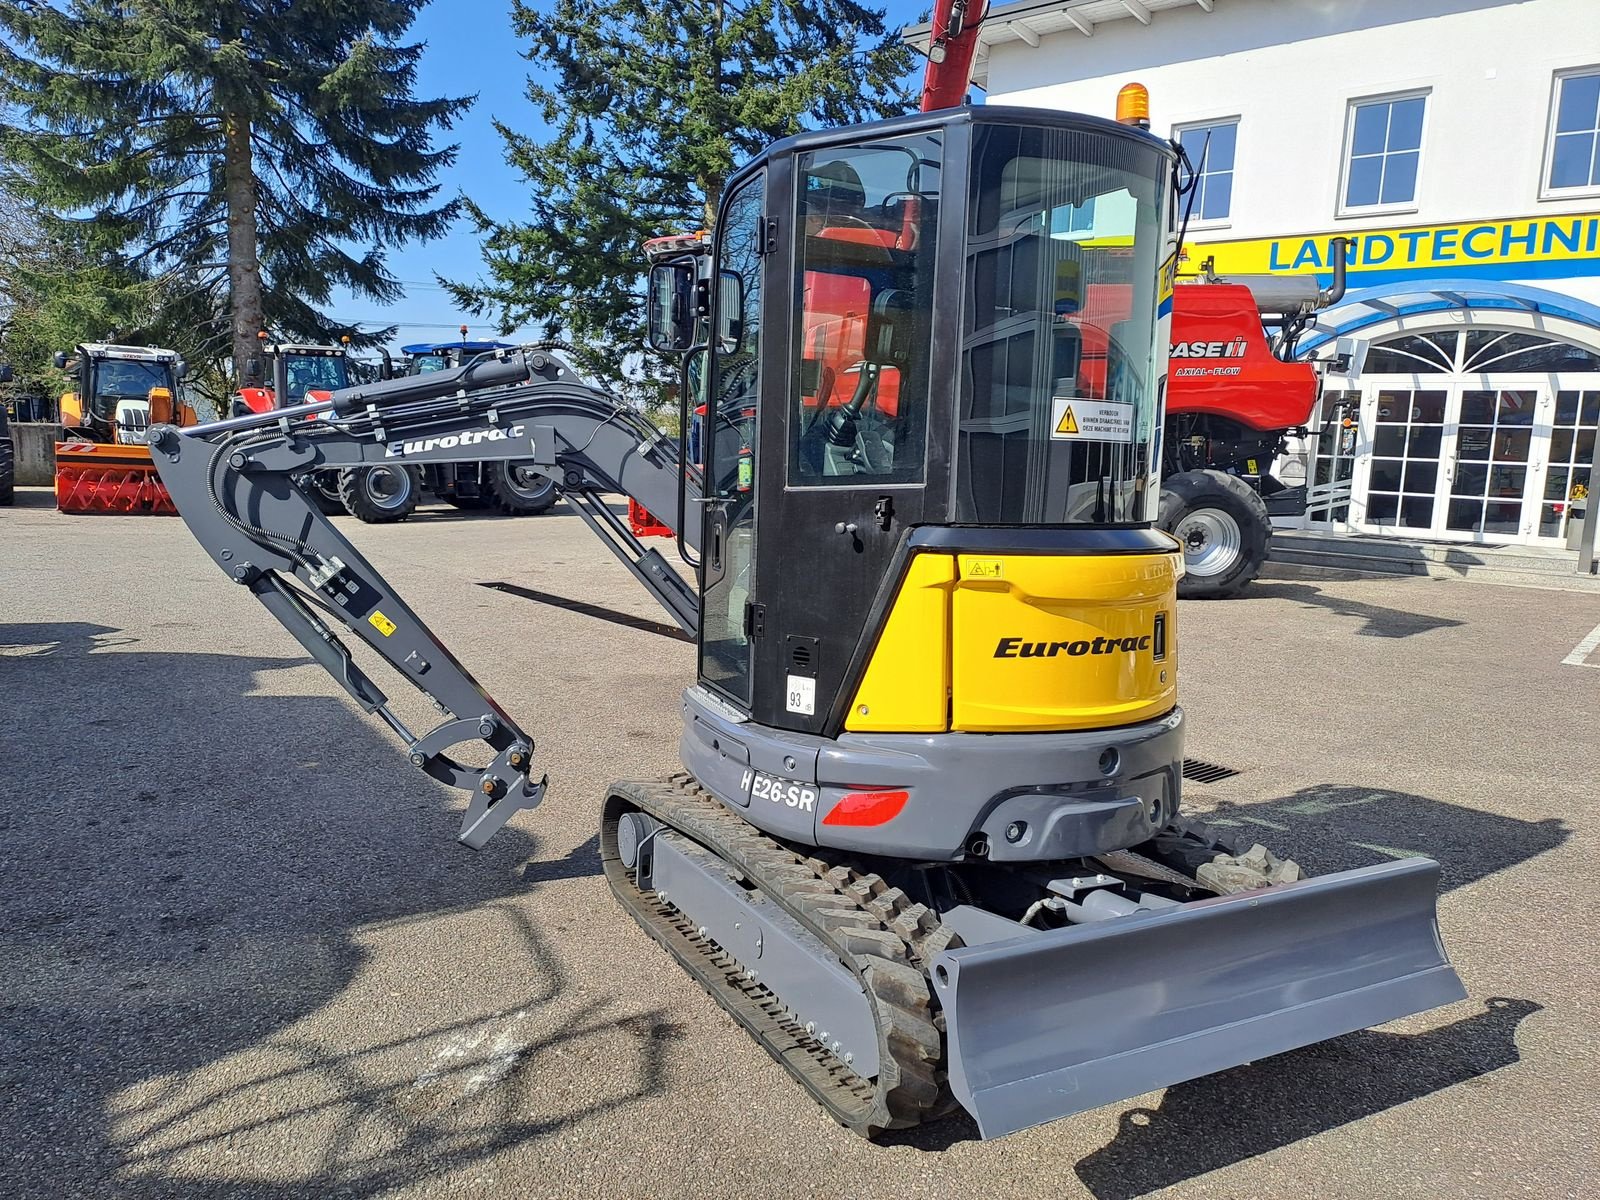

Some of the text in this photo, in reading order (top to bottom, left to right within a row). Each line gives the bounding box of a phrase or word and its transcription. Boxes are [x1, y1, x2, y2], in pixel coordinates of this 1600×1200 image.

[1269, 218, 1599, 270] LANDTECHNI
[385, 425, 525, 457] Eurotrac
[993, 635, 1151, 658] Eurotrac
[790, 691, 801, 707] 93
[740, 770, 815, 812] HE26-SR
